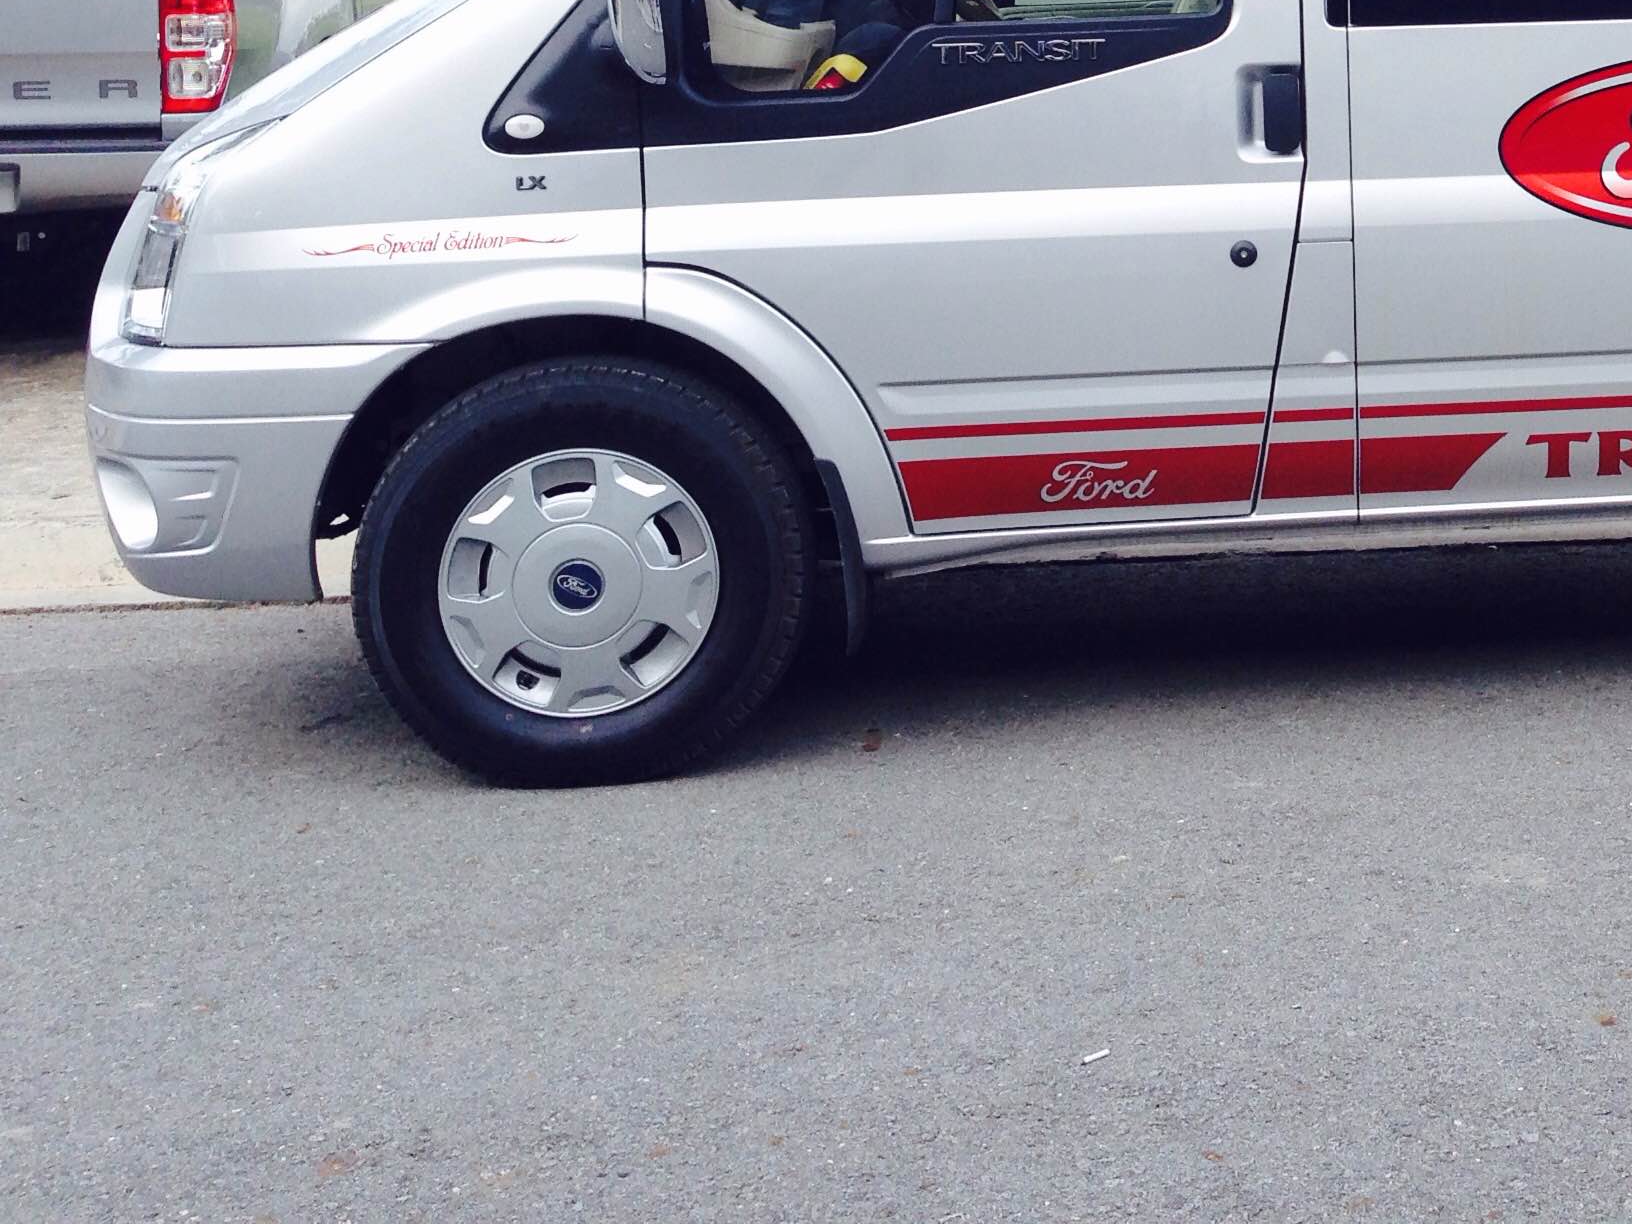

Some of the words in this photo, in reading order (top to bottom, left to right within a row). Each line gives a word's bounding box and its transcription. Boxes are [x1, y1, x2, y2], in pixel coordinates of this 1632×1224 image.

[931, 38, 1106, 65] TRANSIT
[515, 176, 547, 191] LX
[376, 232, 440, 260] Special
[444, 230, 504, 250] Edition
[1040, 460, 1158, 503] Ford
[561, 576, 592, 596] Ford
